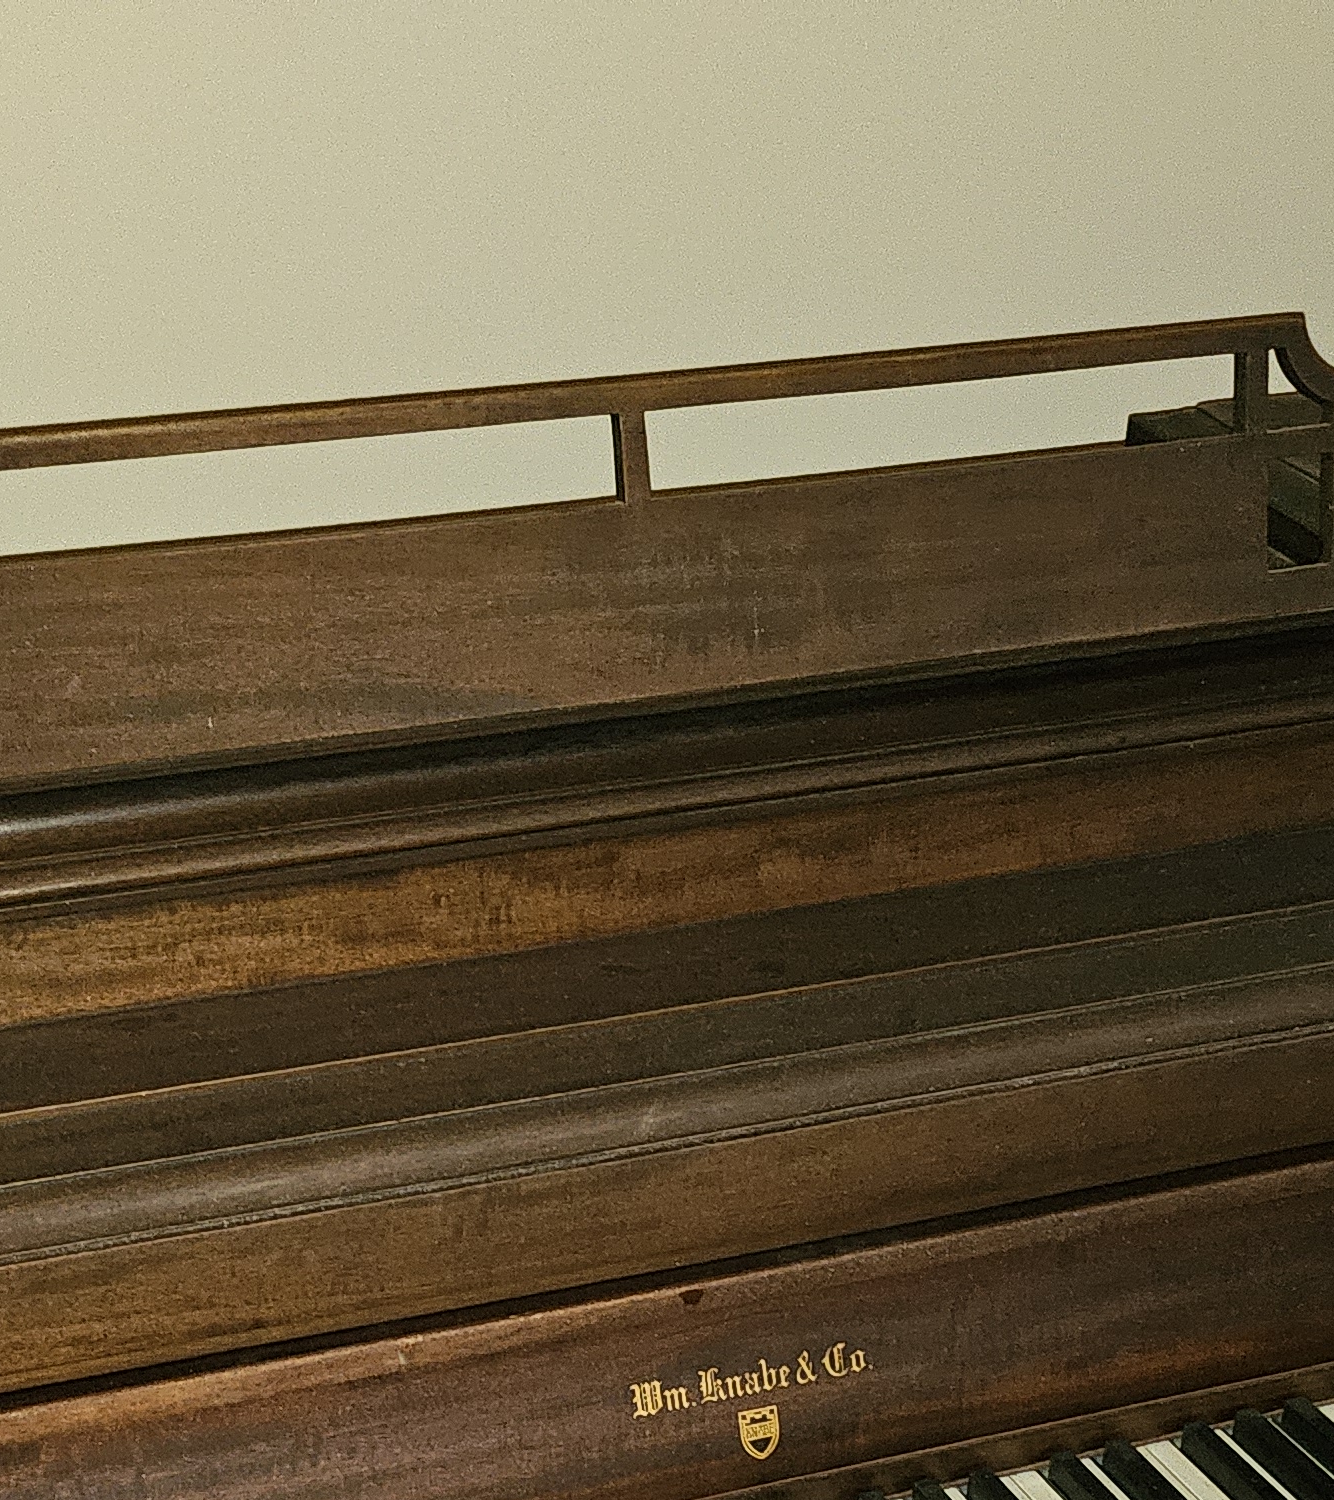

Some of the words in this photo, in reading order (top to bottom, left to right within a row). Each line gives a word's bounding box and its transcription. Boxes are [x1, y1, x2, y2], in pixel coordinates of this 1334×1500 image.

[629, 1379, 697, 1420] Wm.
[698, 1358, 790, 1405] Knabe
[796, 1350, 818, 1384] &
